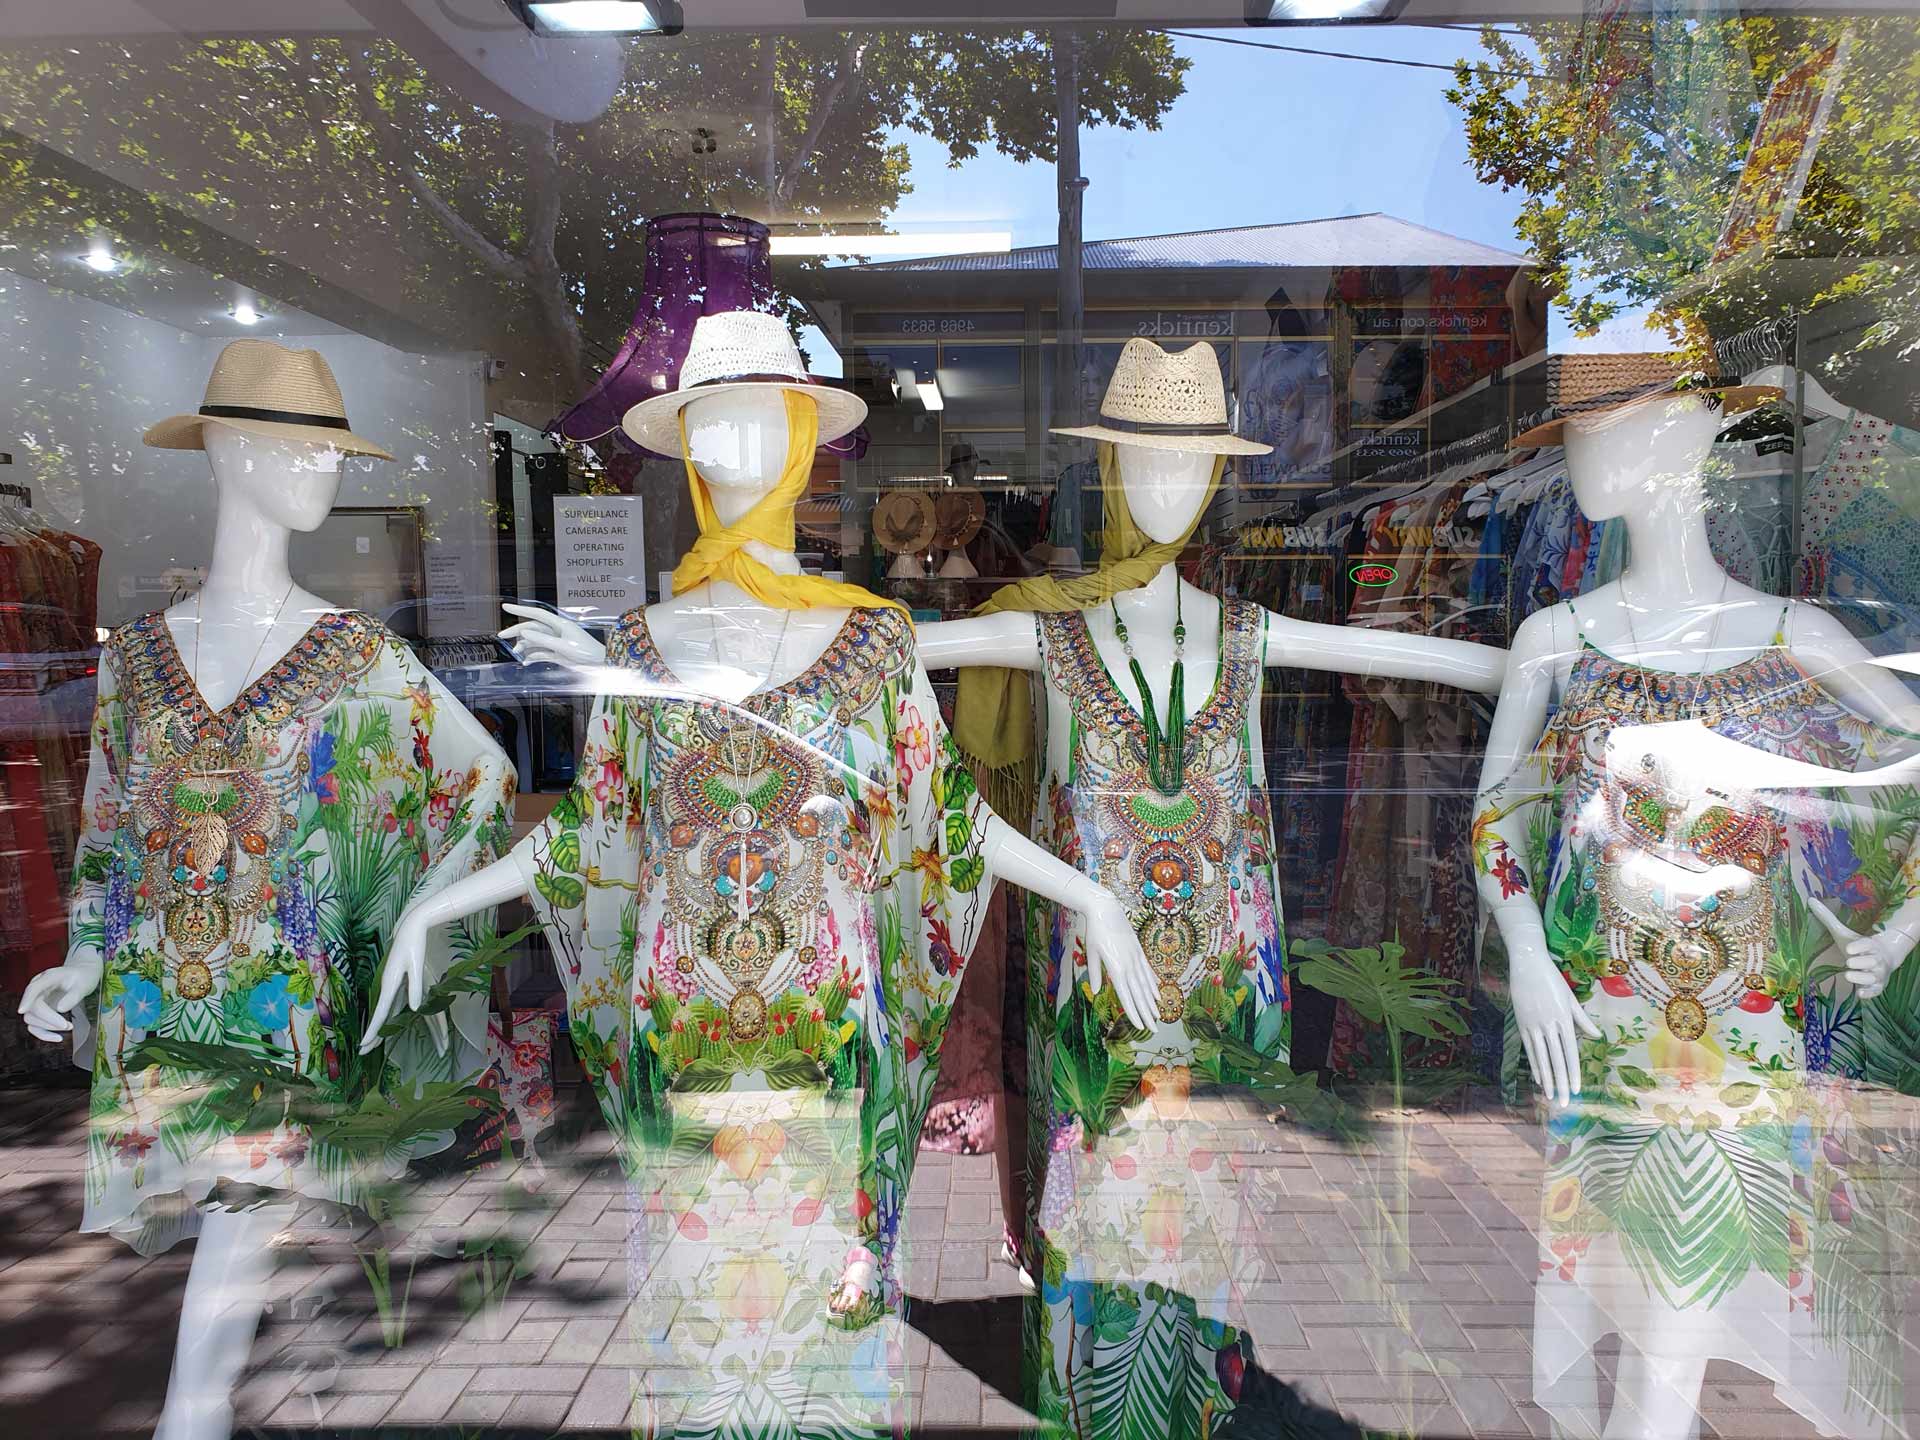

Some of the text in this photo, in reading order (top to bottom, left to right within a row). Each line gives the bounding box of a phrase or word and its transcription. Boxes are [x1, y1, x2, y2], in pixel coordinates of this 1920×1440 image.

[564, 510, 629, 518] SURVEILLANCE
[565, 526, 628, 536] CAMERAS ARE
[573, 543, 624, 551] OPERATING
[566, 558, 624, 566] SHOPLIFTERS
[577, 575, 611, 583] WILL BE
[568, 590, 626, 598] PROSECUTED
